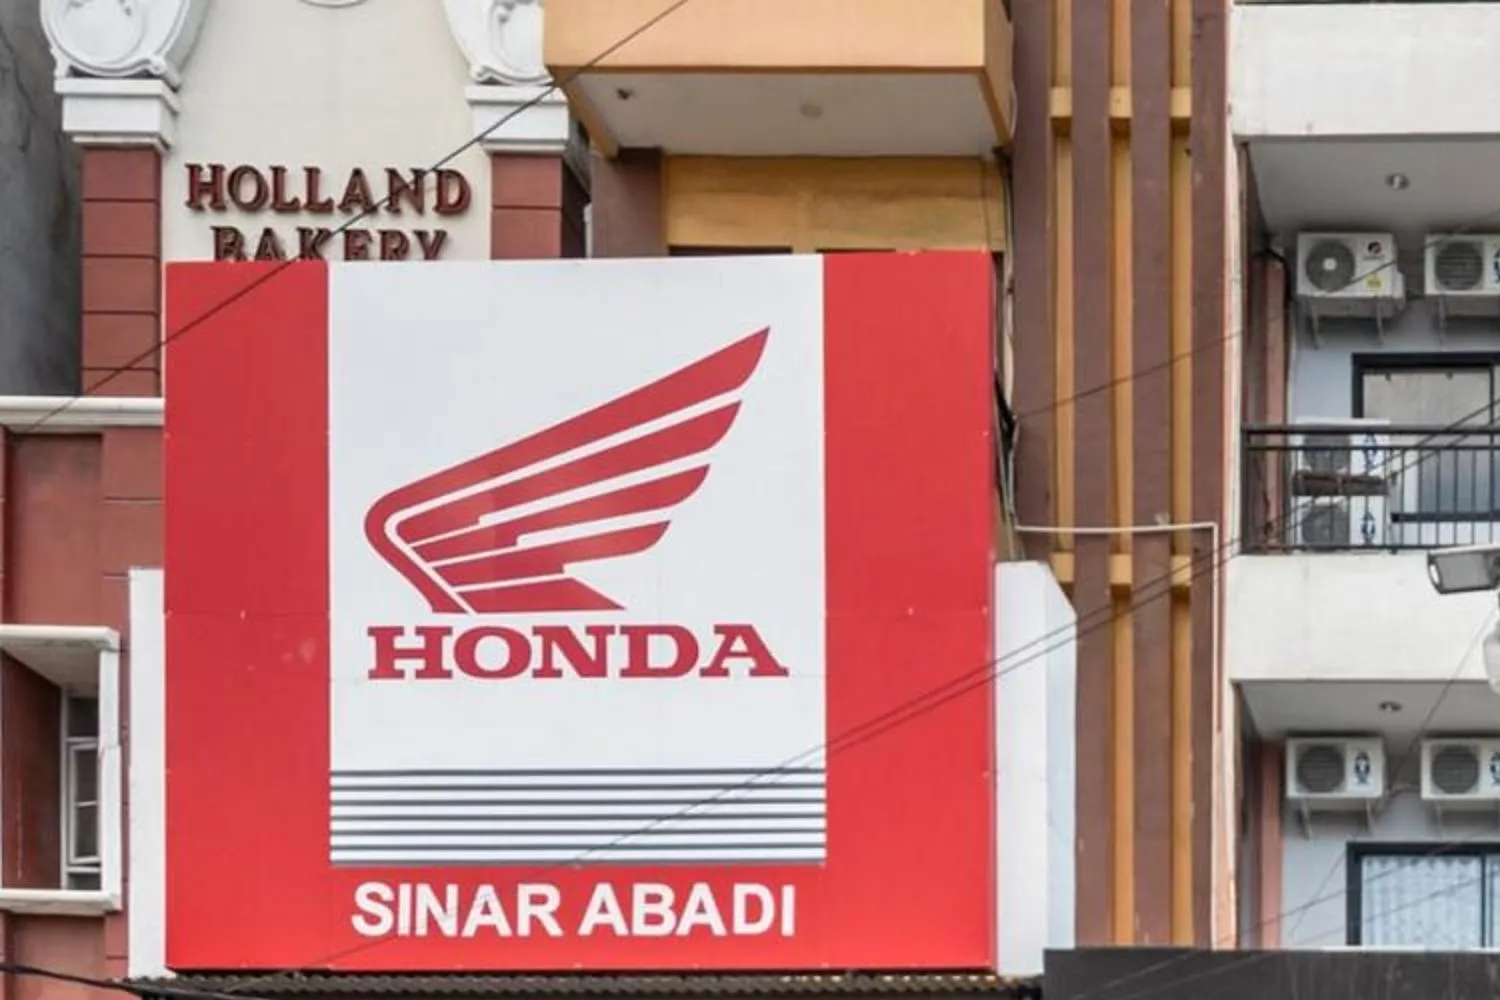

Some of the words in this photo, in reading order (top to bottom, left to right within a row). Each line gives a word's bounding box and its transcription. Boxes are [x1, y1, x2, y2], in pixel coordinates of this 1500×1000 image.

[185, 163, 472, 216] HOLLAND
[210, 226, 448, 261] BAKERY
[367, 624, 789, 680] HONDA
[351, 881, 564, 937] SINAR
[578, 882, 795, 937] ABADI
